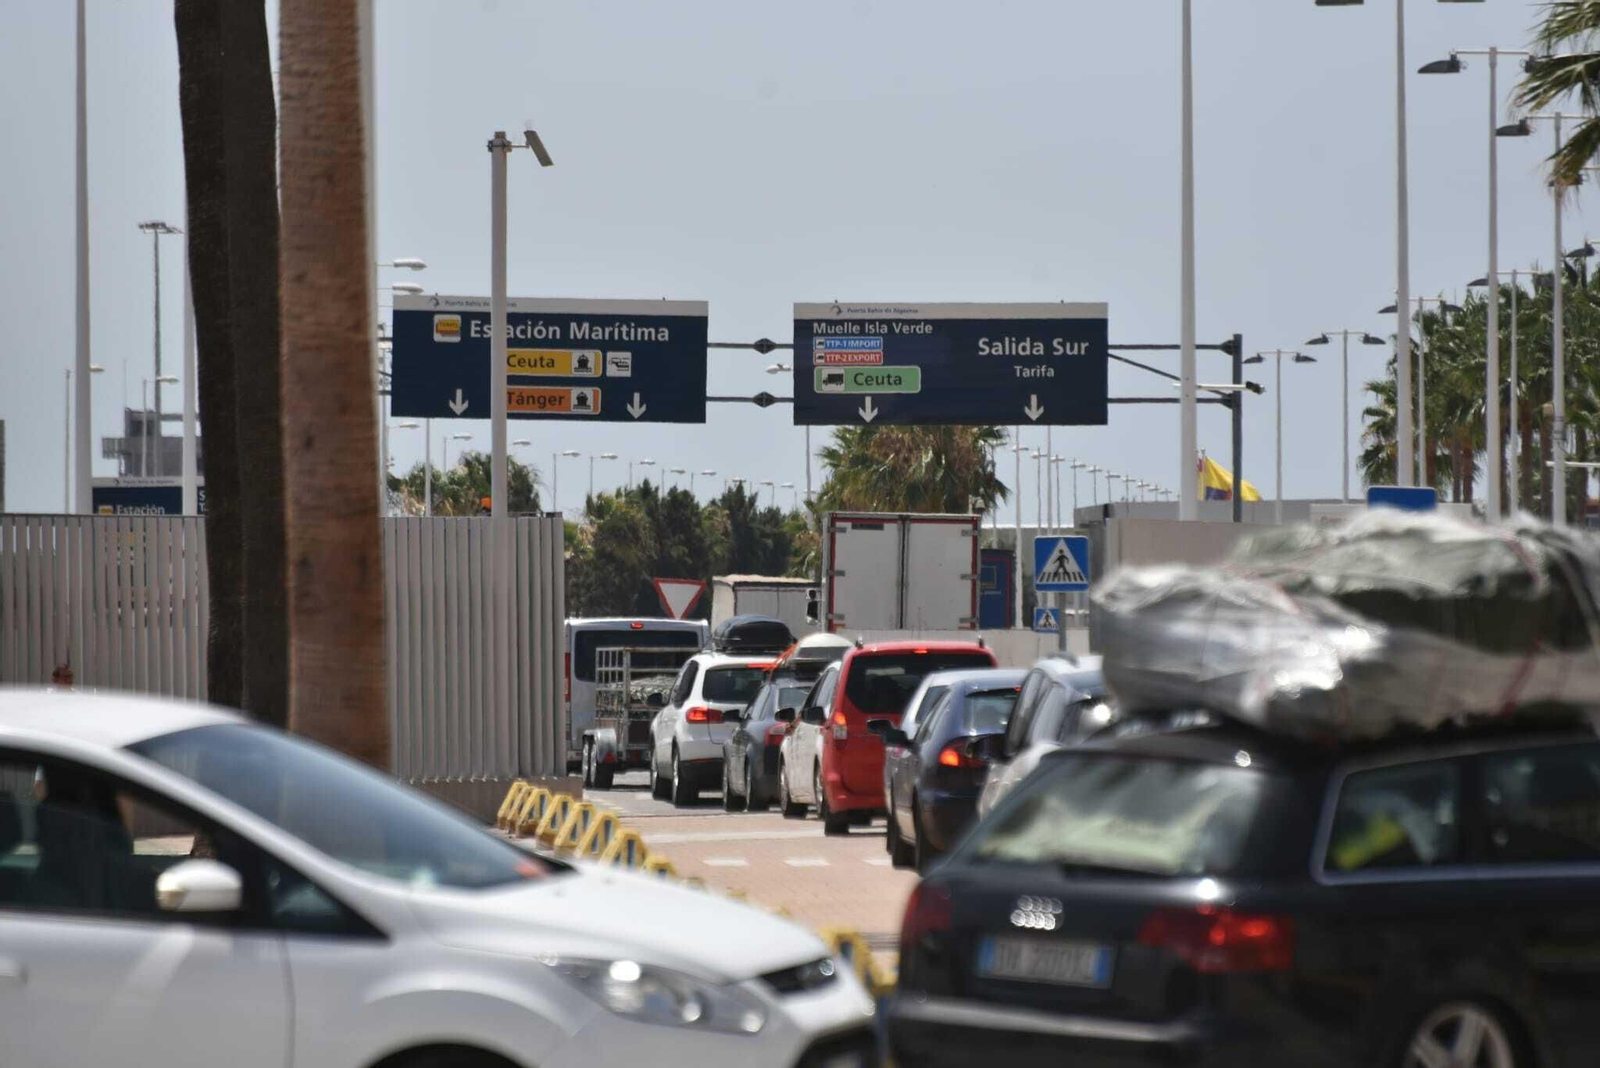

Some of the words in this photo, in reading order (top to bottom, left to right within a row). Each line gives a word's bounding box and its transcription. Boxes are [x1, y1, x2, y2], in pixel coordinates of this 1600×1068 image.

[469, 319, 561, 339] Esación
[569, 321, 669, 342] Marítima
[813, 322, 860, 335] Muelle
[865, 322, 888, 335] Isla
[892, 322, 933, 335] Verde
[826, 340, 847, 348] TTP-1
[848, 340, 881, 348] IMPORT
[978, 337, 1045, 356] Salida
[1052, 337, 1089, 356] Sur
[507, 354, 556, 369] Ceuta
[826, 354, 847, 362] TTP-2
[848, 354, 881, 362] EXPORT
[1014, 365, 1055, 378] Tarifa
[853, 372, 902, 386] Ceuta
[507, 390, 565, 409] Tánger
[117, 504, 166, 515] Estación
